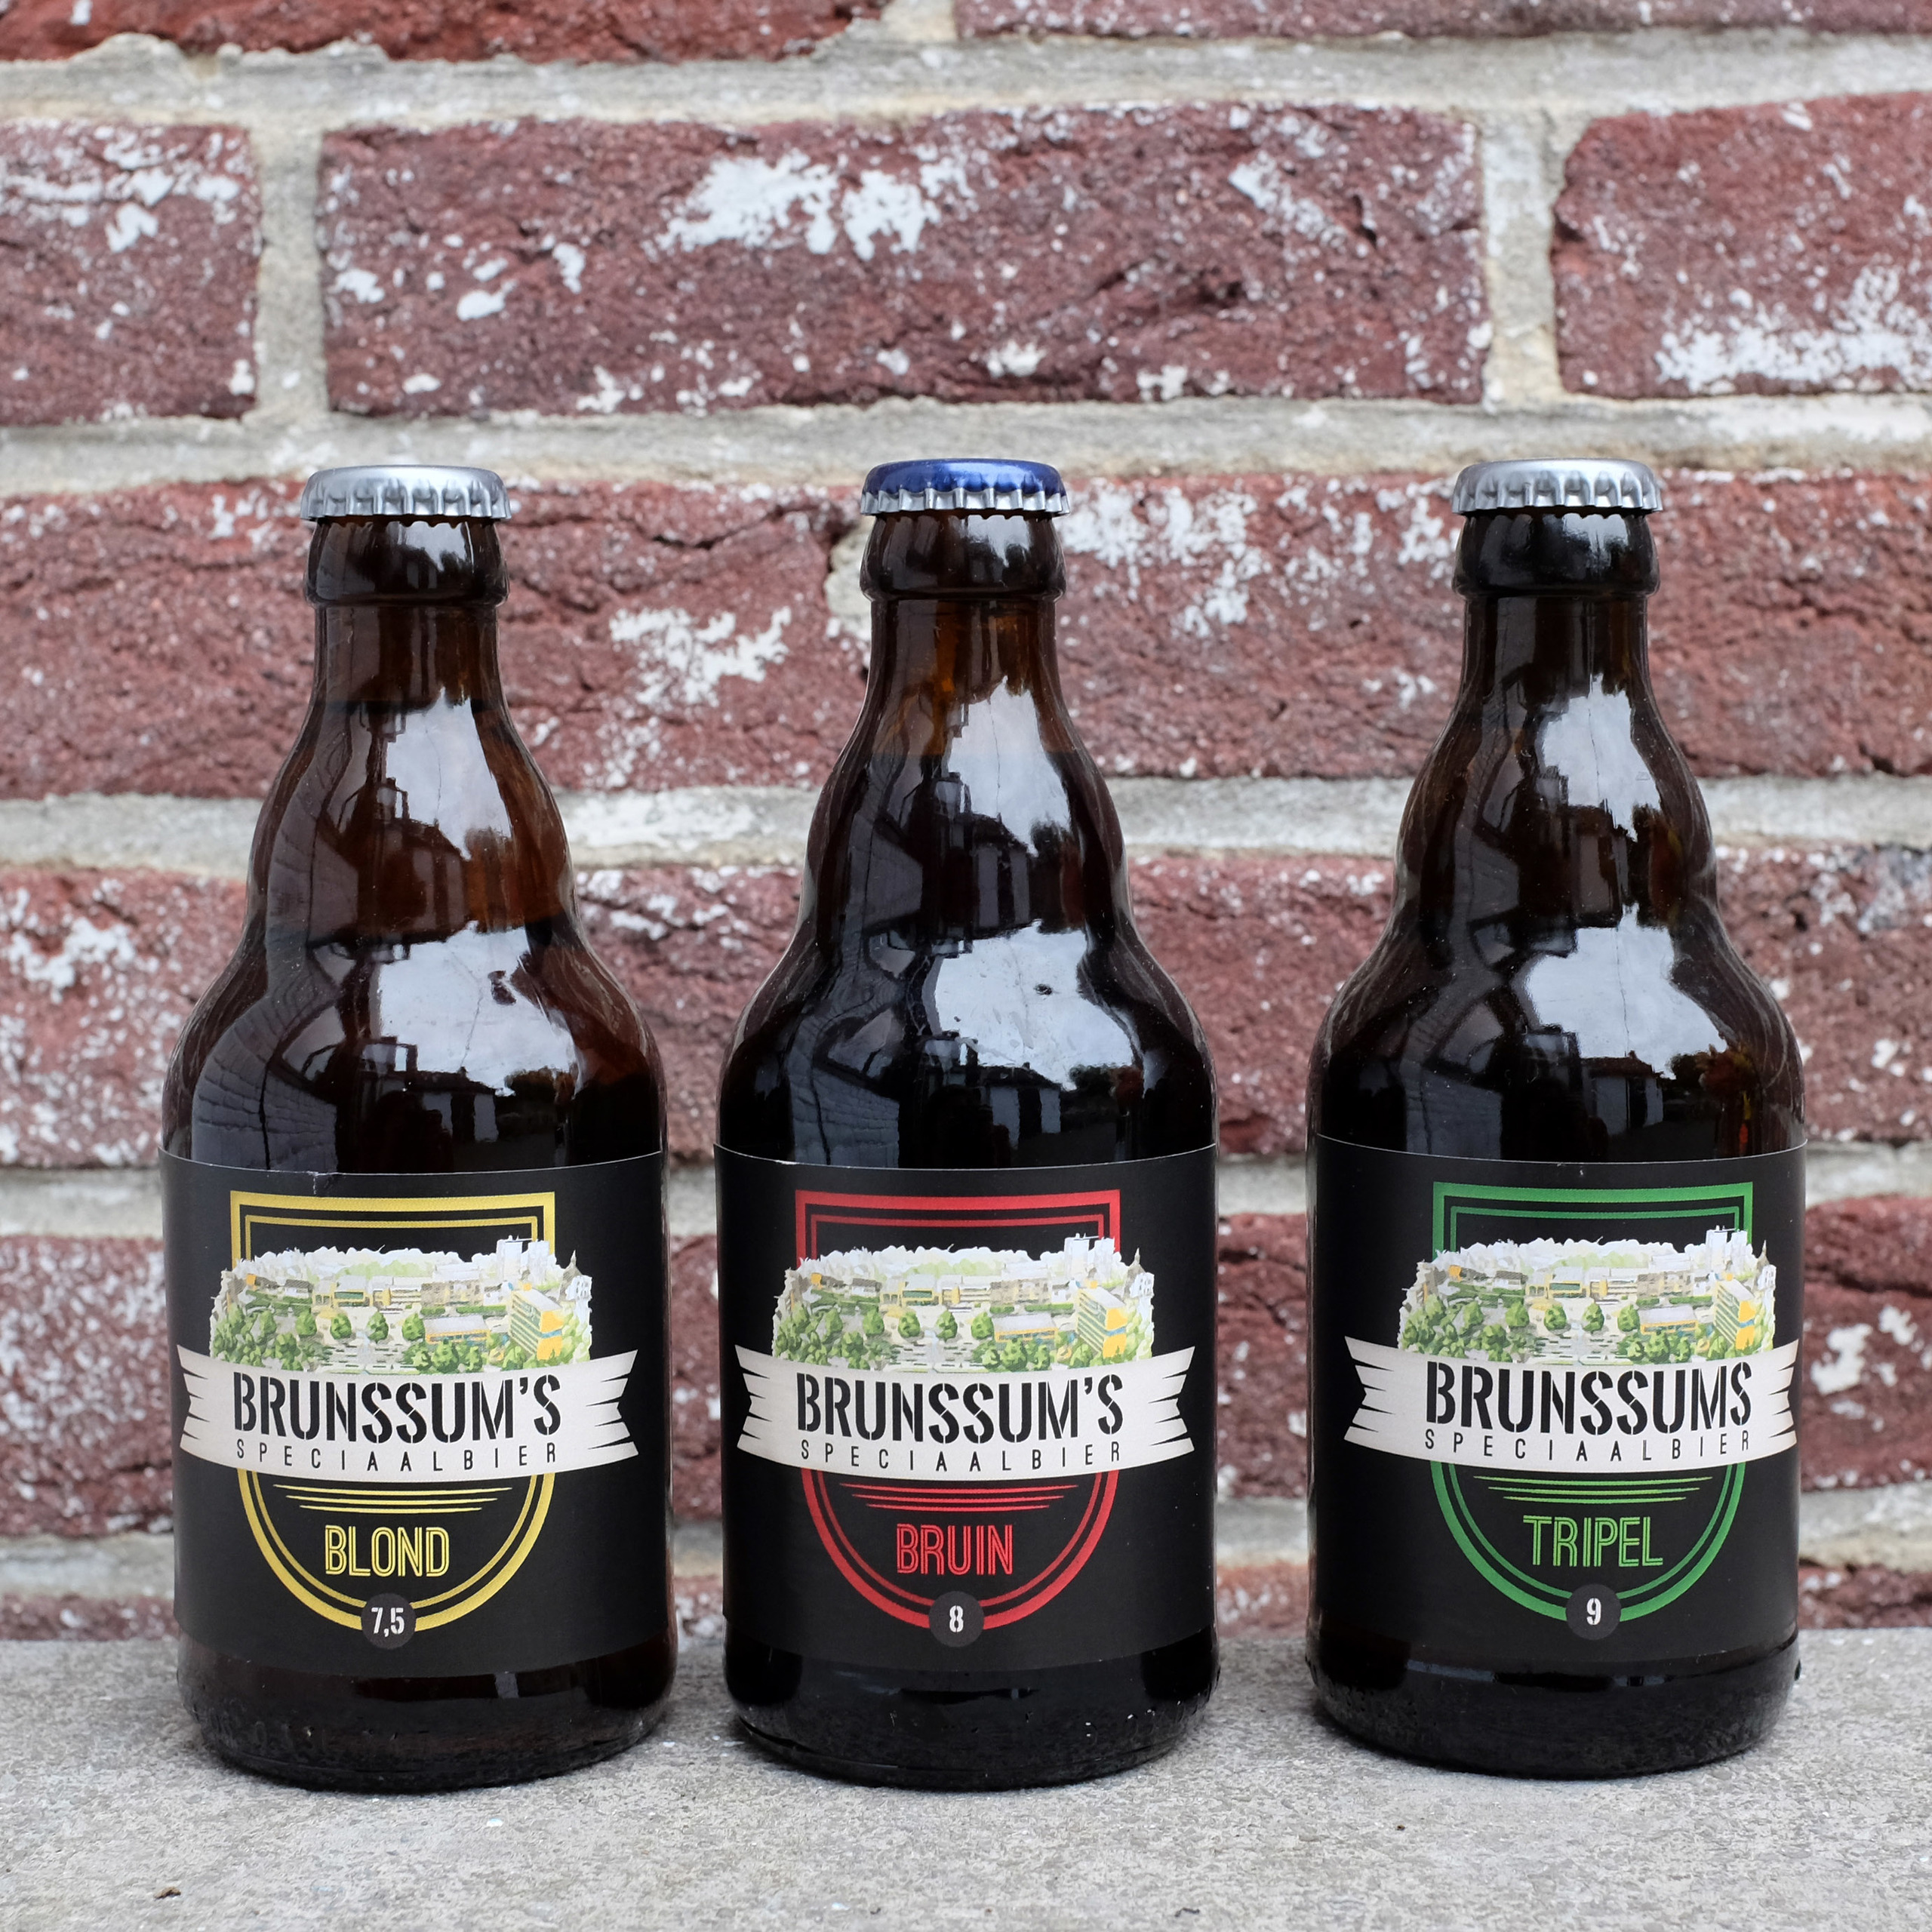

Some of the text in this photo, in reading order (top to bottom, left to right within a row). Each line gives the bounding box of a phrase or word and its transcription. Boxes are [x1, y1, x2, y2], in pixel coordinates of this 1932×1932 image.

[233, 1371, 562, 1444] BRUNSSUM'S
[796, 1373, 1124, 1444] BRUNSSUM'S
[1426, 1361, 1752, 1435] BRUNSSUMS
[236, 1438, 557, 1472] SPECIAALBIER
[800, 1440, 1121, 1472] SPECIAALBIER
[1425, 1429, 1749, 1462] SPECIAALBIER
[324, 1524, 451, 1577] BLOND
[896, 1523, 1014, 1575] BRUIN
[1523, 1514, 1664, 1567] TRIPEL
[371, 1607, 405, 1636] 7,5
[949, 1604, 964, 1632] 8
[1586, 1597, 1602, 1626] 9
